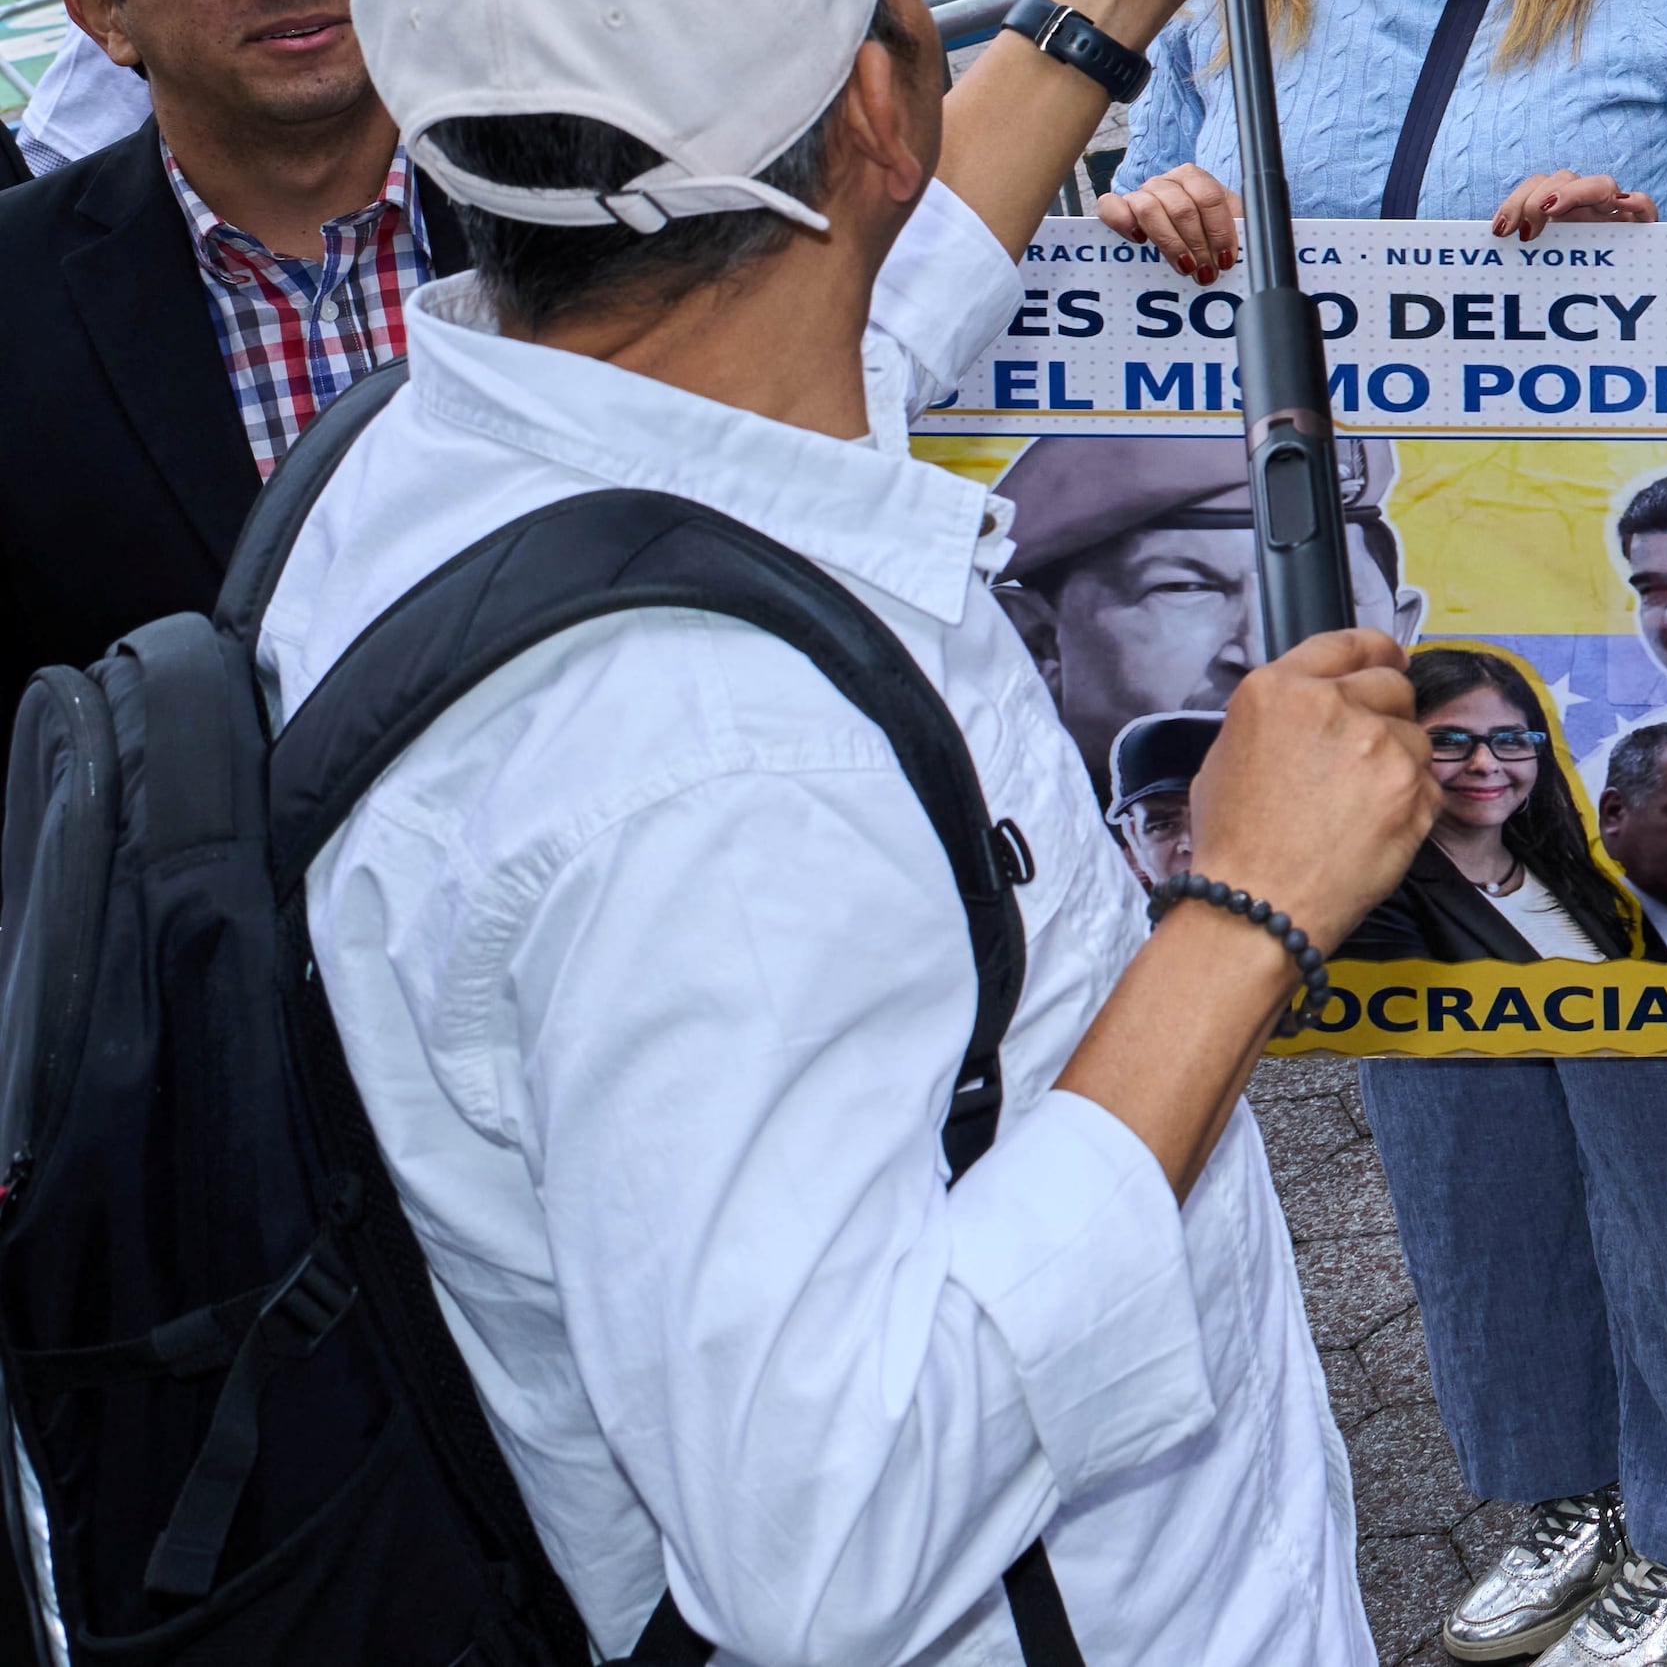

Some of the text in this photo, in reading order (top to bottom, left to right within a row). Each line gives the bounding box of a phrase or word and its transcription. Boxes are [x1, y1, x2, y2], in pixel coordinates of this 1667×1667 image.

[1026, 241, 1616, 268] RACIÓN NUEVA YORK
[1007, 289, 1658, 342] ES SOO DELCY
[993, 360, 1094, 411] EL
